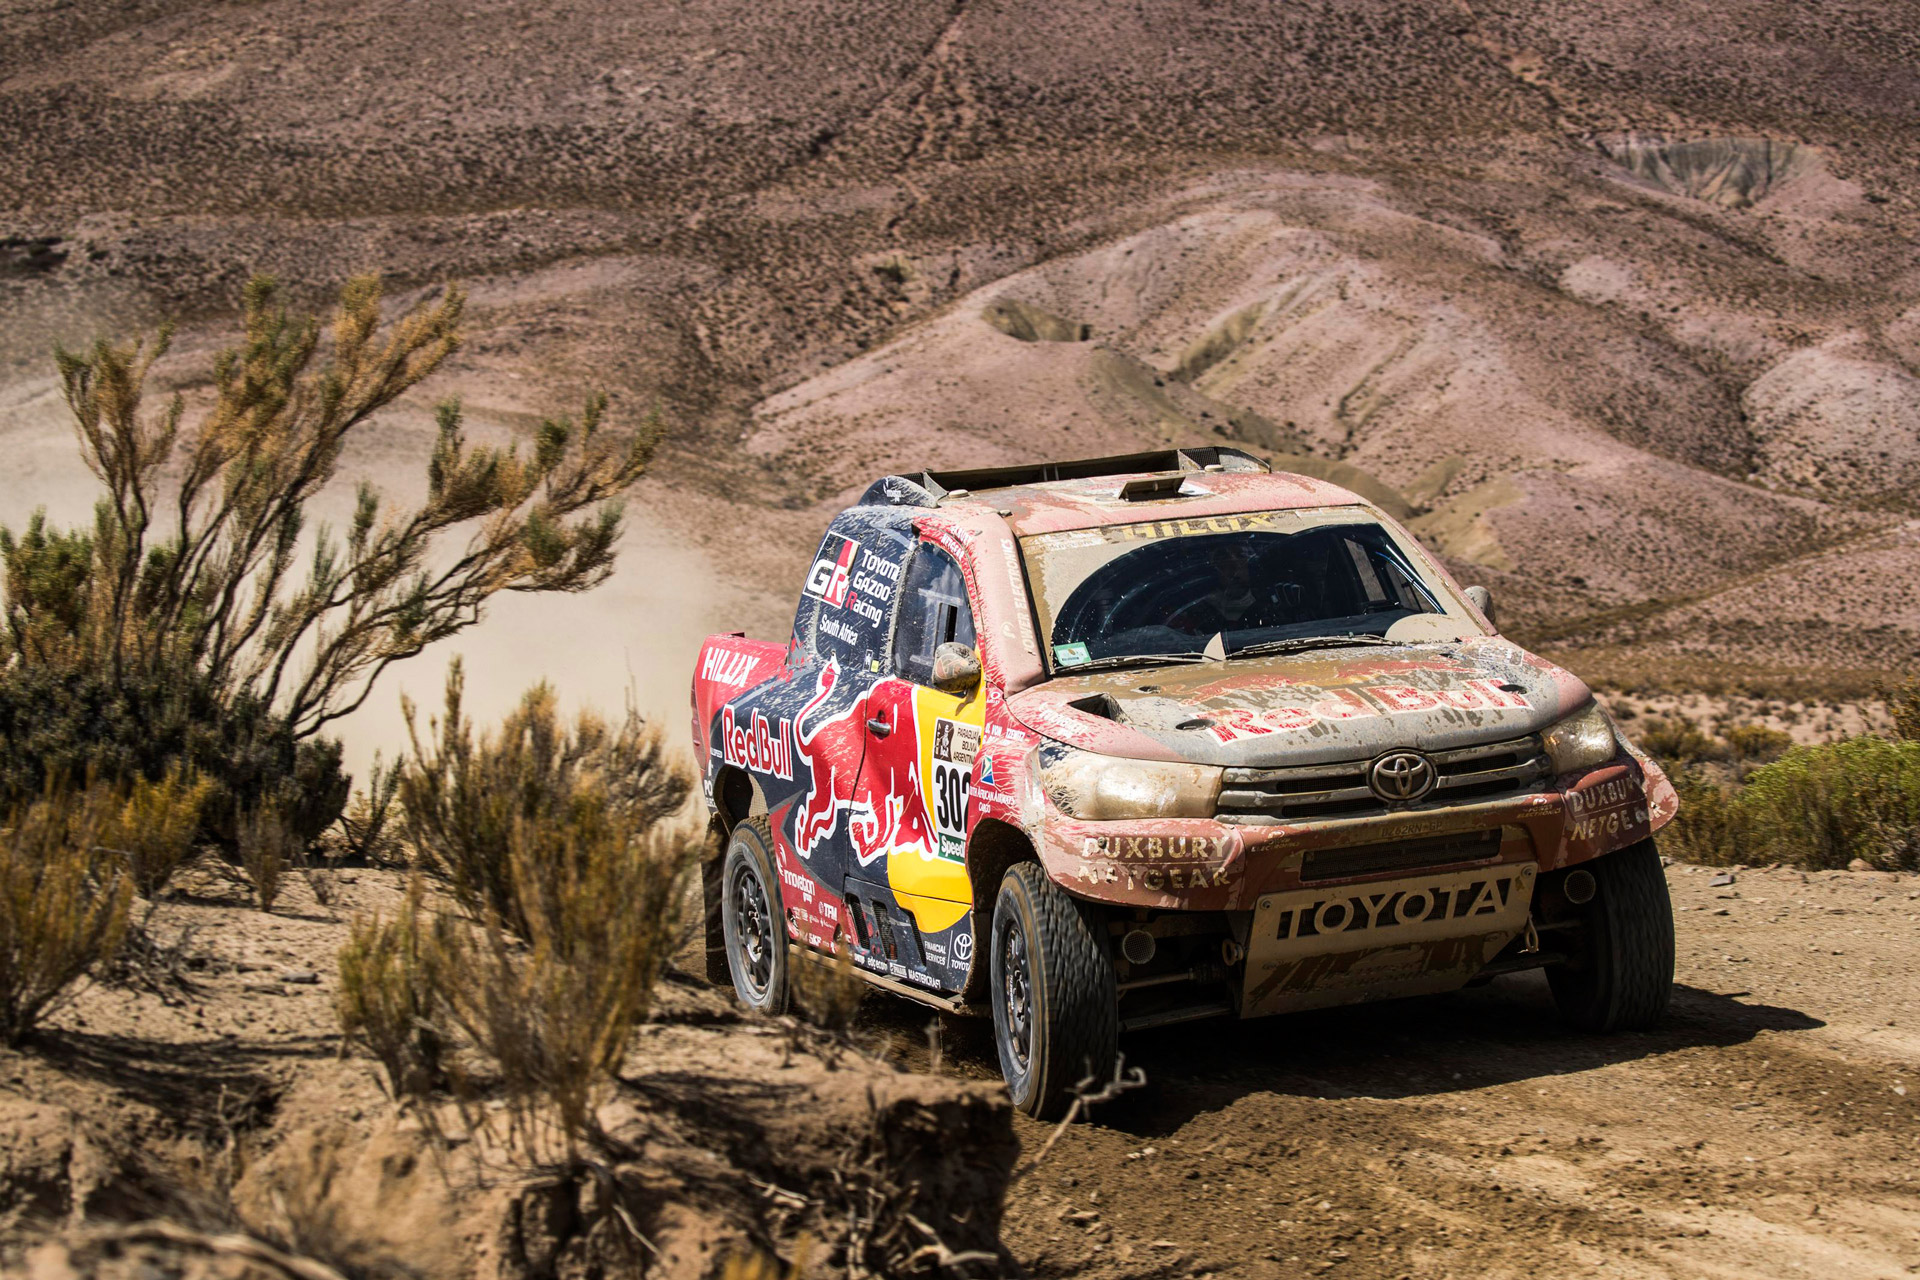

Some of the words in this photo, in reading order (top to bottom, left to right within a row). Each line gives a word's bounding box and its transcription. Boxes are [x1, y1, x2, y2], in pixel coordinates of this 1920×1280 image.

[806, 558, 849, 604] GR
[852, 571, 891, 602] GAZOO
[845, 591, 883, 628] Racing
[819, 614, 839, 637] South
[838, 622, 859, 646] Africa
[701, 646, 760, 688] HILUX
[957, 727, 980, 741] PARAGUAY
[823, 903, 839, 922] TFM
[1281, 877, 1508, 940] TOYOTA
[924, 940, 946, 955] FINANCIAL
[925, 951, 946, 966] SERVICES
